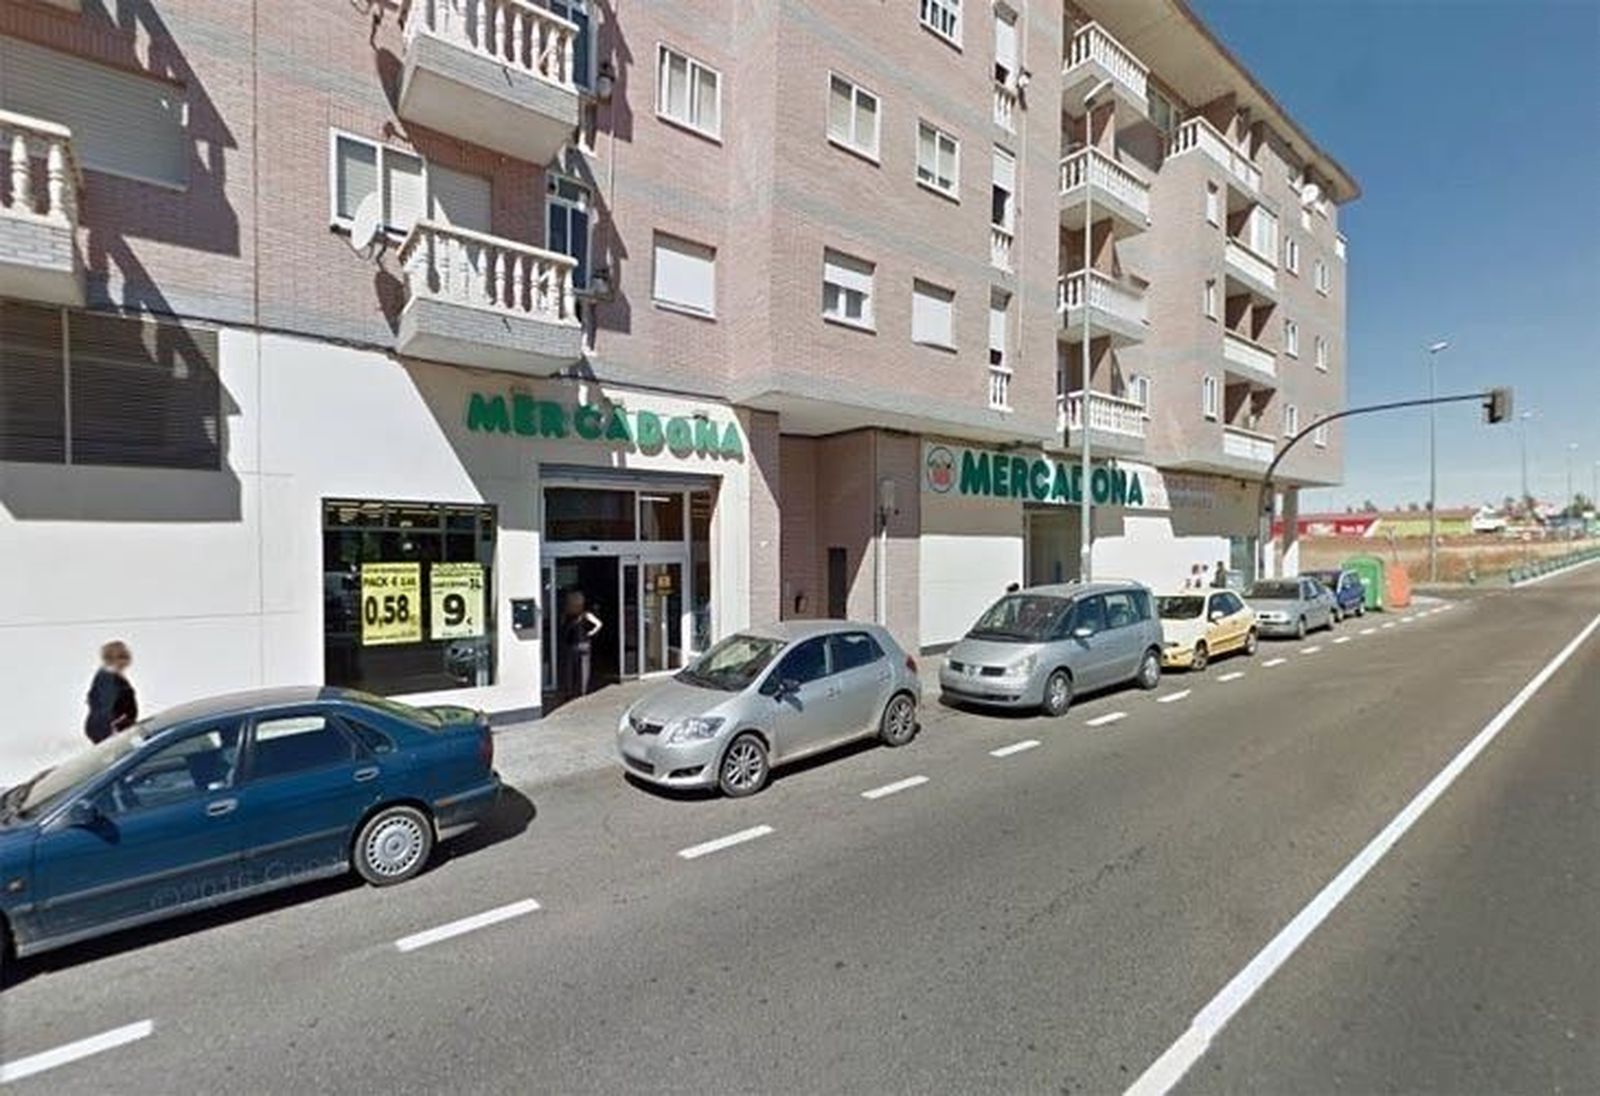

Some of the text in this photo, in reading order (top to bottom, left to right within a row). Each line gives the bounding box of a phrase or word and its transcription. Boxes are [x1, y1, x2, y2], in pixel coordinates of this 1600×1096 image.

[467, 391, 745, 462] MERCADONA
[960, 449, 1144, 506] MERCADONA
[364, 594, 409, 628] 0,58
[443, 593, 466, 626] 9
